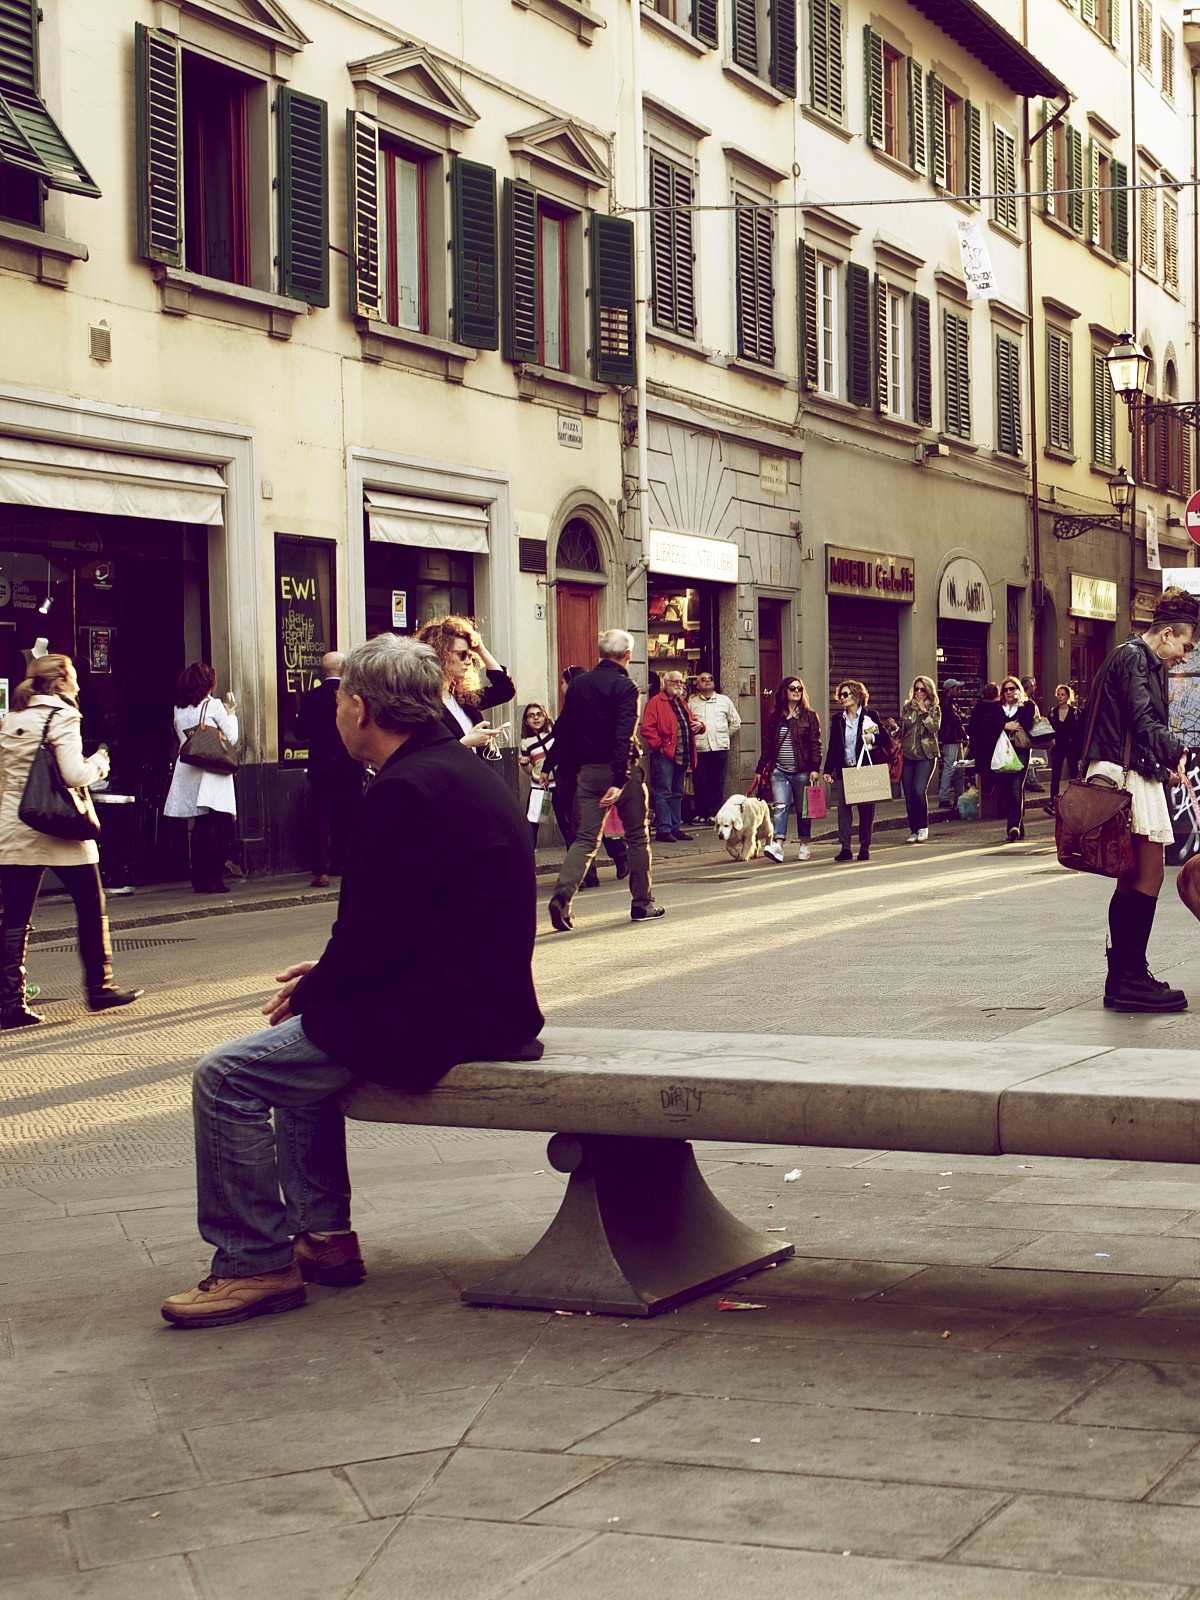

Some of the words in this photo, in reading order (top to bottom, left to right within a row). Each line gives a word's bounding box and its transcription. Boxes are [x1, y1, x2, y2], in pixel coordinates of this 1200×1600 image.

[655, 541, 687, 565] LIBRERIE
[829, 556, 873, 589] MOBILI
[280, 576, 316, 601] EW!
